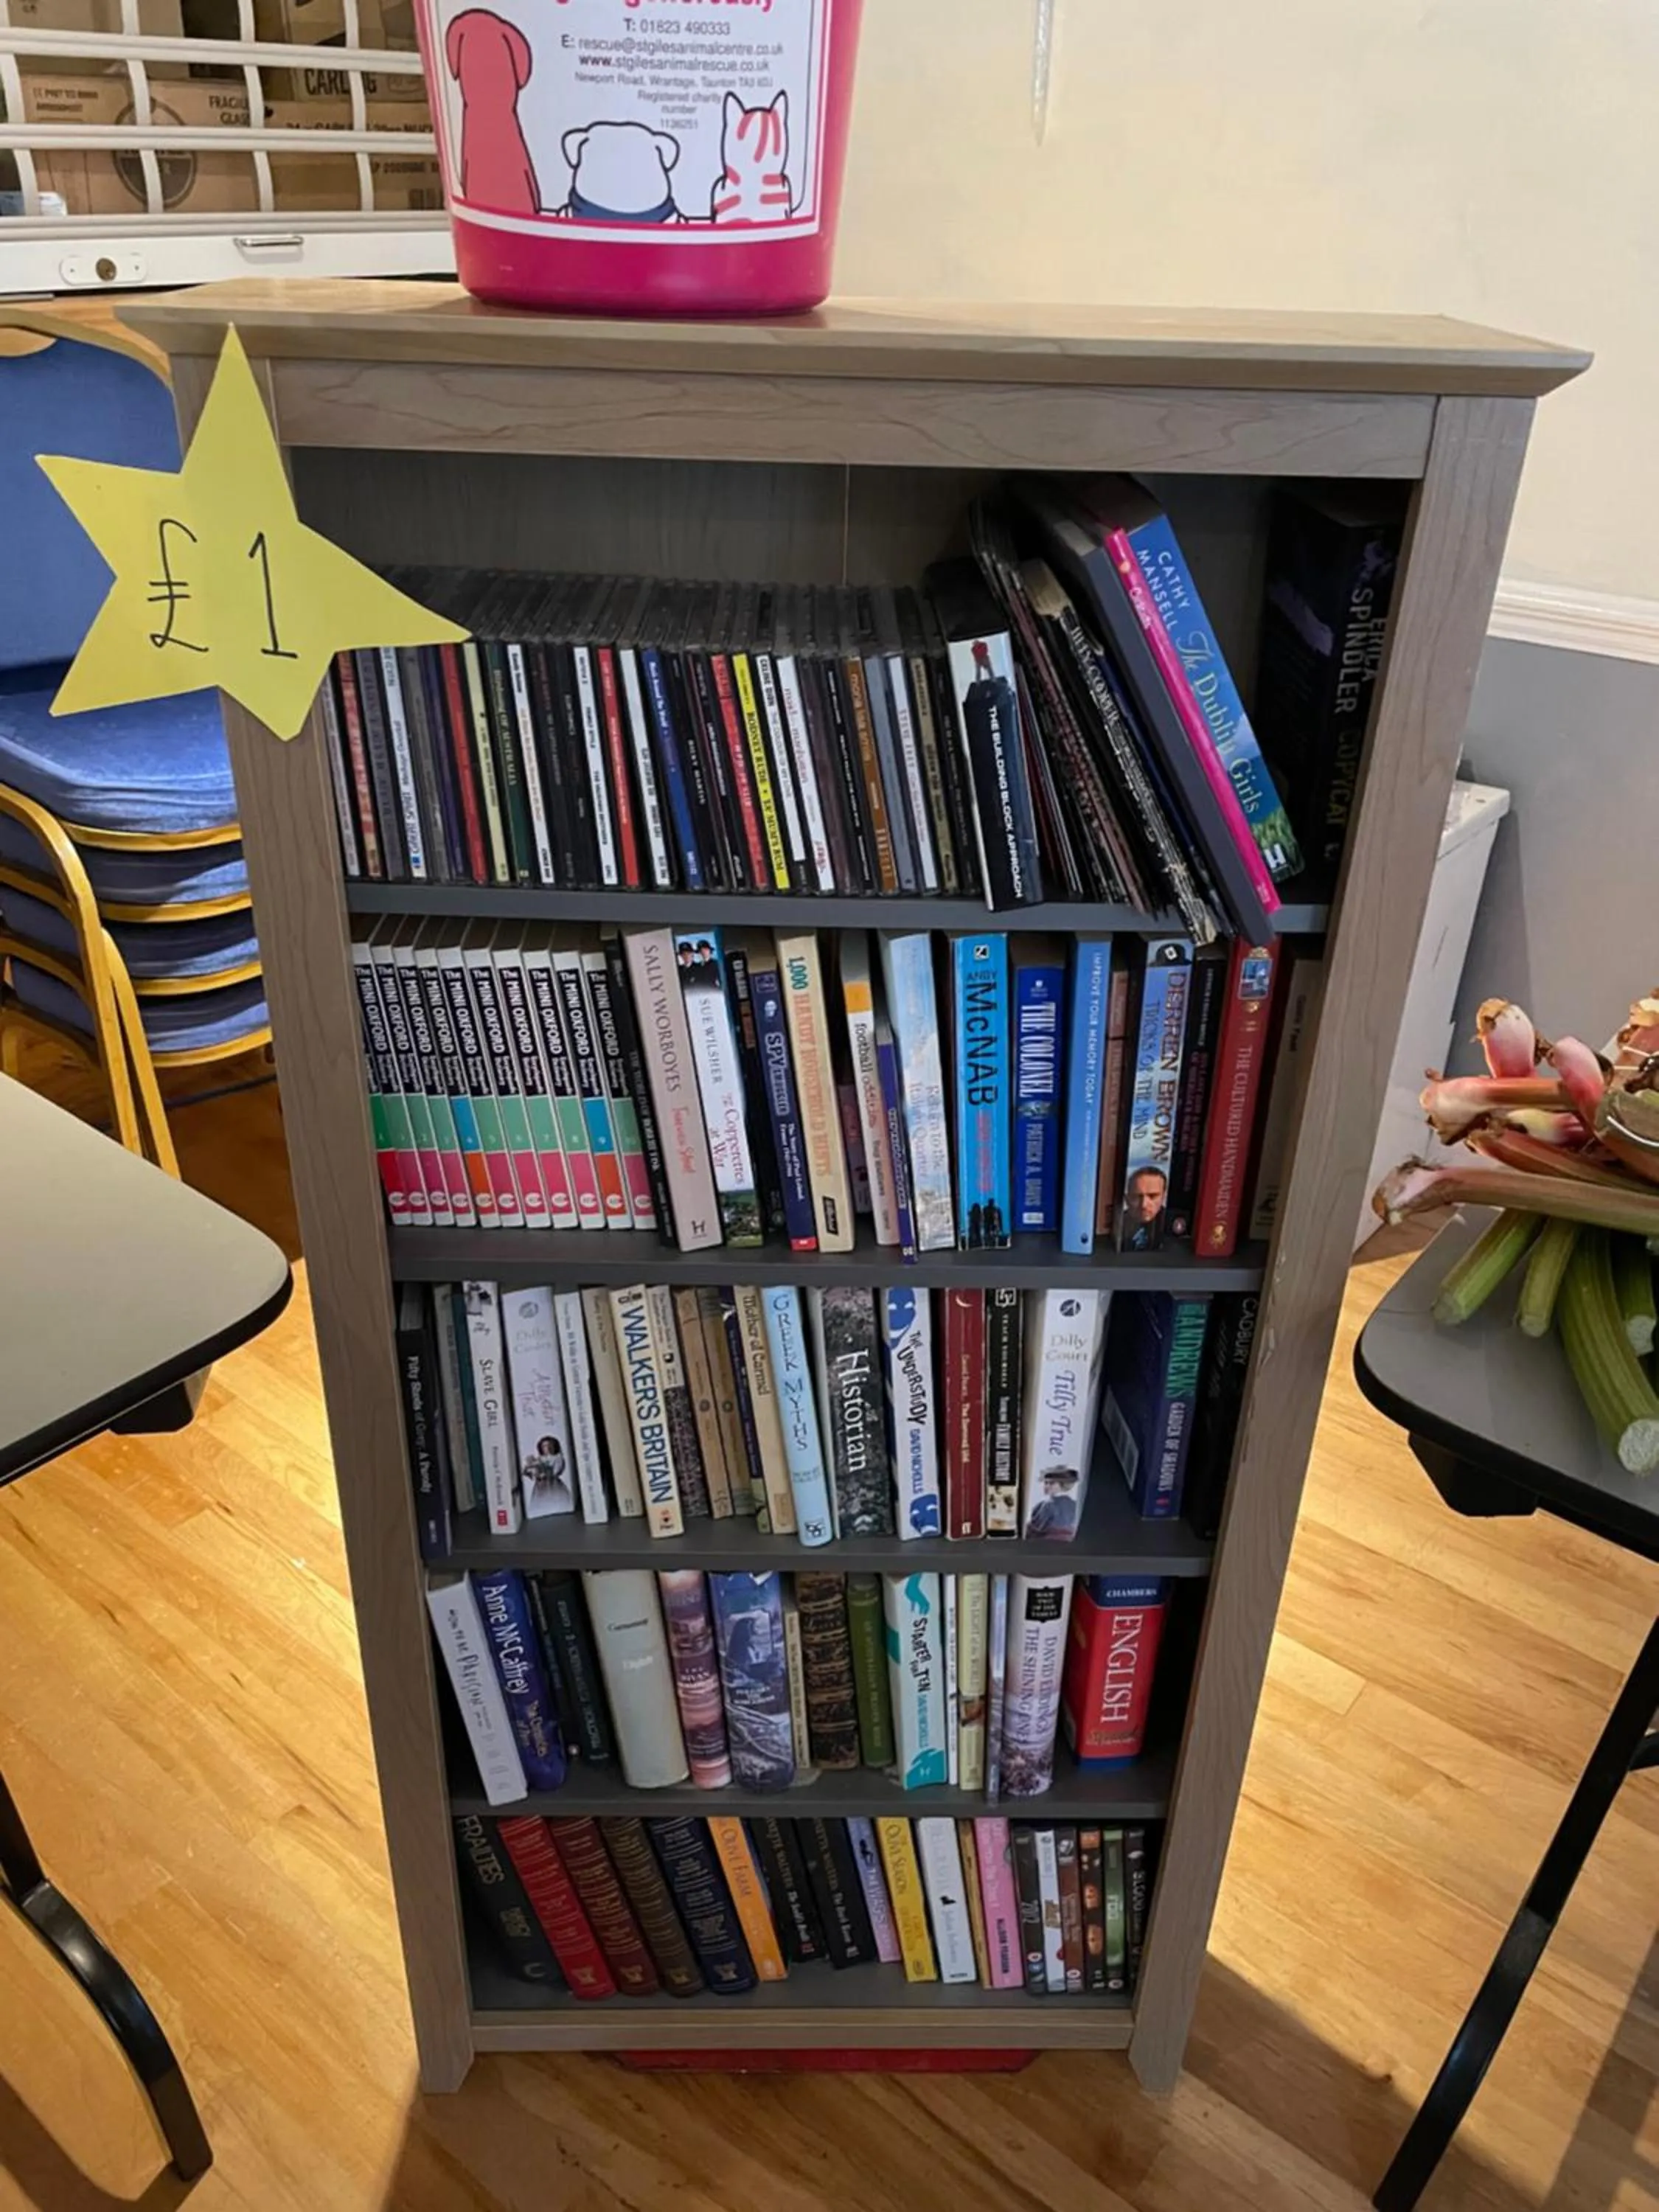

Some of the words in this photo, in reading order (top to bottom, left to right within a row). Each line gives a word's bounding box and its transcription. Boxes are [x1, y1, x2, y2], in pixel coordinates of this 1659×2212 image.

[1133, 546, 1181, 630] MANSELL
[1155, 549, 1192, 612] CATHY
[1172, 627, 1214, 674] The
[1332, 585, 1374, 716] SPINDLER
[985, 704, 1000, 732] THE
[1190, 669, 1247, 757] Dublin
[753, 754, 769, 785] RUDE
[990, 730, 1009, 790] BUILDING
[1225, 752, 1270, 816] Girls
[999, 790, 1016, 832] BLOCK
[1006, 832, 1026, 898] APPROACH
[383, 978, 400, 1003] MINI
[643, 944, 665, 993] SALLY
[785, 956, 809, 990] 1,000
[1091, 953, 1105, 996] IMPROVE
[360, 978, 378, 1004] MINI
[405, 979, 422, 1005] MINI
[424, 980, 443, 1006] MINI
[449, 981, 466, 1006] MINI
[477, 981, 494, 1005] MINI
[506, 980, 523, 1005] MINI
[535, 981, 552, 1006] MINI
[564, 983, 580, 1007] MINI
[594, 983, 613, 1009] MINI
[698, 998, 714, 1024] SUE
[1088, 999, 1101, 1026] YOUR
[365, 1005, 386, 1051] OXFORD
[388, 1004, 410, 1050] OXFORD
[410, 1006, 431, 1052] OXFORD
[431, 1006, 454, 1053] OXFORD
[456, 1008, 477, 1053] OXFORD
[483, 1007, 504, 1053] OXFORD
[512, 1007, 532, 1053] OXFORD
[541, 1008, 563, 1054] OXFORD
[569, 1009, 589, 1054] OXFORD
[599, 1009, 620, 1056] OXFORD
[790, 993, 815, 1044] HANDY
[1020, 1004, 1056, 1032] THE
[1158, 970, 1188, 1072] DERREN
[652, 998, 681, 1093] WORBOYES
[702, 1026, 723, 1085] WILSHER
[764, 1031, 786, 1068] SPY
[854, 1023, 872, 1072] football
[965, 981, 998, 1106] McNAB
[1085, 1029, 1098, 1070] MEMORY
[1235, 1046, 1251, 1068] THE
[1018, 1036, 1056, 1098] COLONEL
[1082, 1073, 1094, 1104] TODAY
[798, 1048, 827, 1131] HOUSEHOLD
[860, 1076, 877, 1129] oddities
[1225, 1068, 1248, 1137] CULTURED
[1130, 1107, 1149, 1142] MIND
[1150, 1077, 1176, 1162] BROWN
[811, 1134, 832, 1177] HINTS
[1025, 1123, 1041, 1162] PATRICK
[1025, 1178, 1042, 1207] DAVIS
[1214, 1139, 1238, 1218] HANDMAIDEN
[742, 1294, 762, 1338] Mother
[1001, 1314, 1009, 1343] TEACH
[1231, 1295, 1257, 1366] CADBURY
[908, 1329, 924, 1349] THE
[1164, 1312, 1206, 1401] ANDREWS
[619, 1305, 661, 1422] WALKER'S
[751, 1352, 770, 1396] Carmel
[897, 1344, 926, 1426] UNDERSTUDY
[1000, 1345, 1009, 1388] YOURSELF
[835, 1347, 870, 1473] Historian
[1047, 1369, 1076, 1412] Tilly
[406, 1354, 421, 1379] Fifty
[417, 1461, 434, 1493] Parody
[482, 1397, 500, 1429] GIRL
[783, 1377, 809, 1452] MYTHS
[1166, 1400, 1186, 1436] GARDEN
[1046, 1415, 1074, 1457] True
[1164, 1436, 1180, 1450] OF
[639, 1423, 672, 1503] BRITAIN
[1157, 1450, 1178, 1494] SHADOWS
[481, 1583, 514, 1624] Anne
[1106, 1586, 1157, 1599] CHAMBERS
[490, 1622, 532, 1696] McCaffrey
[908, 1617, 932, 1661] STARTER
[1024, 1624, 1040, 1652] THE
[1040, 1635, 1057, 1677] DAVID
[911, 1669, 931, 1692] TEN
[1020, 1655, 1037, 1705] SHINING
[1100, 1612, 1143, 1724] ENGLISH
[457, 1814, 506, 1887] FRAILTIES
